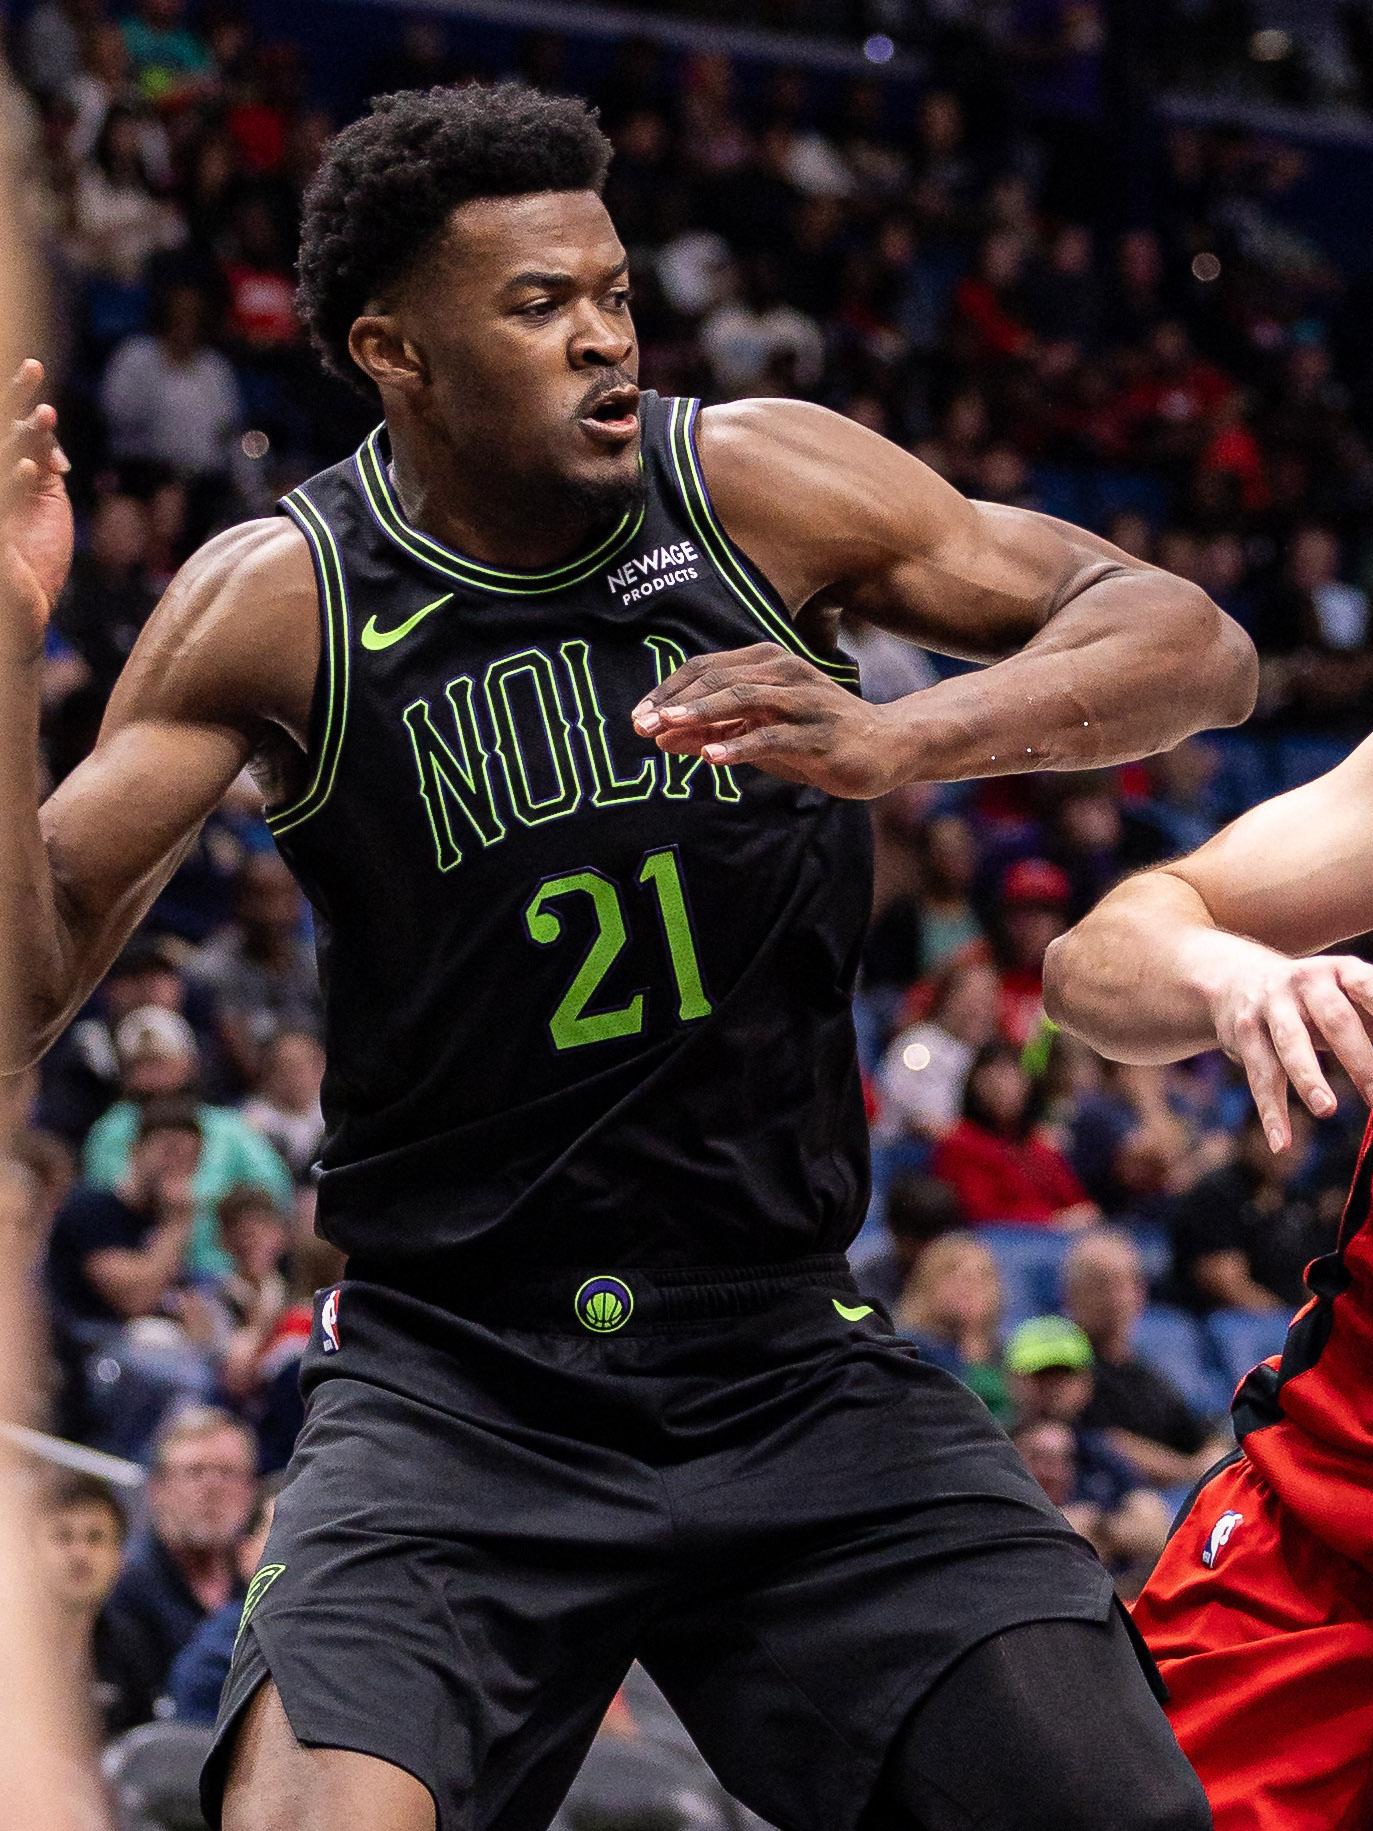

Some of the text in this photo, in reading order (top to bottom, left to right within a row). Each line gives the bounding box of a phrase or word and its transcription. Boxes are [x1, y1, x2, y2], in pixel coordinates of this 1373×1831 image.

[607, 540, 699, 594] NEWAGE
[622, 567, 698, 606] PRODUCTS
[524, 848, 714, 1052] 21
